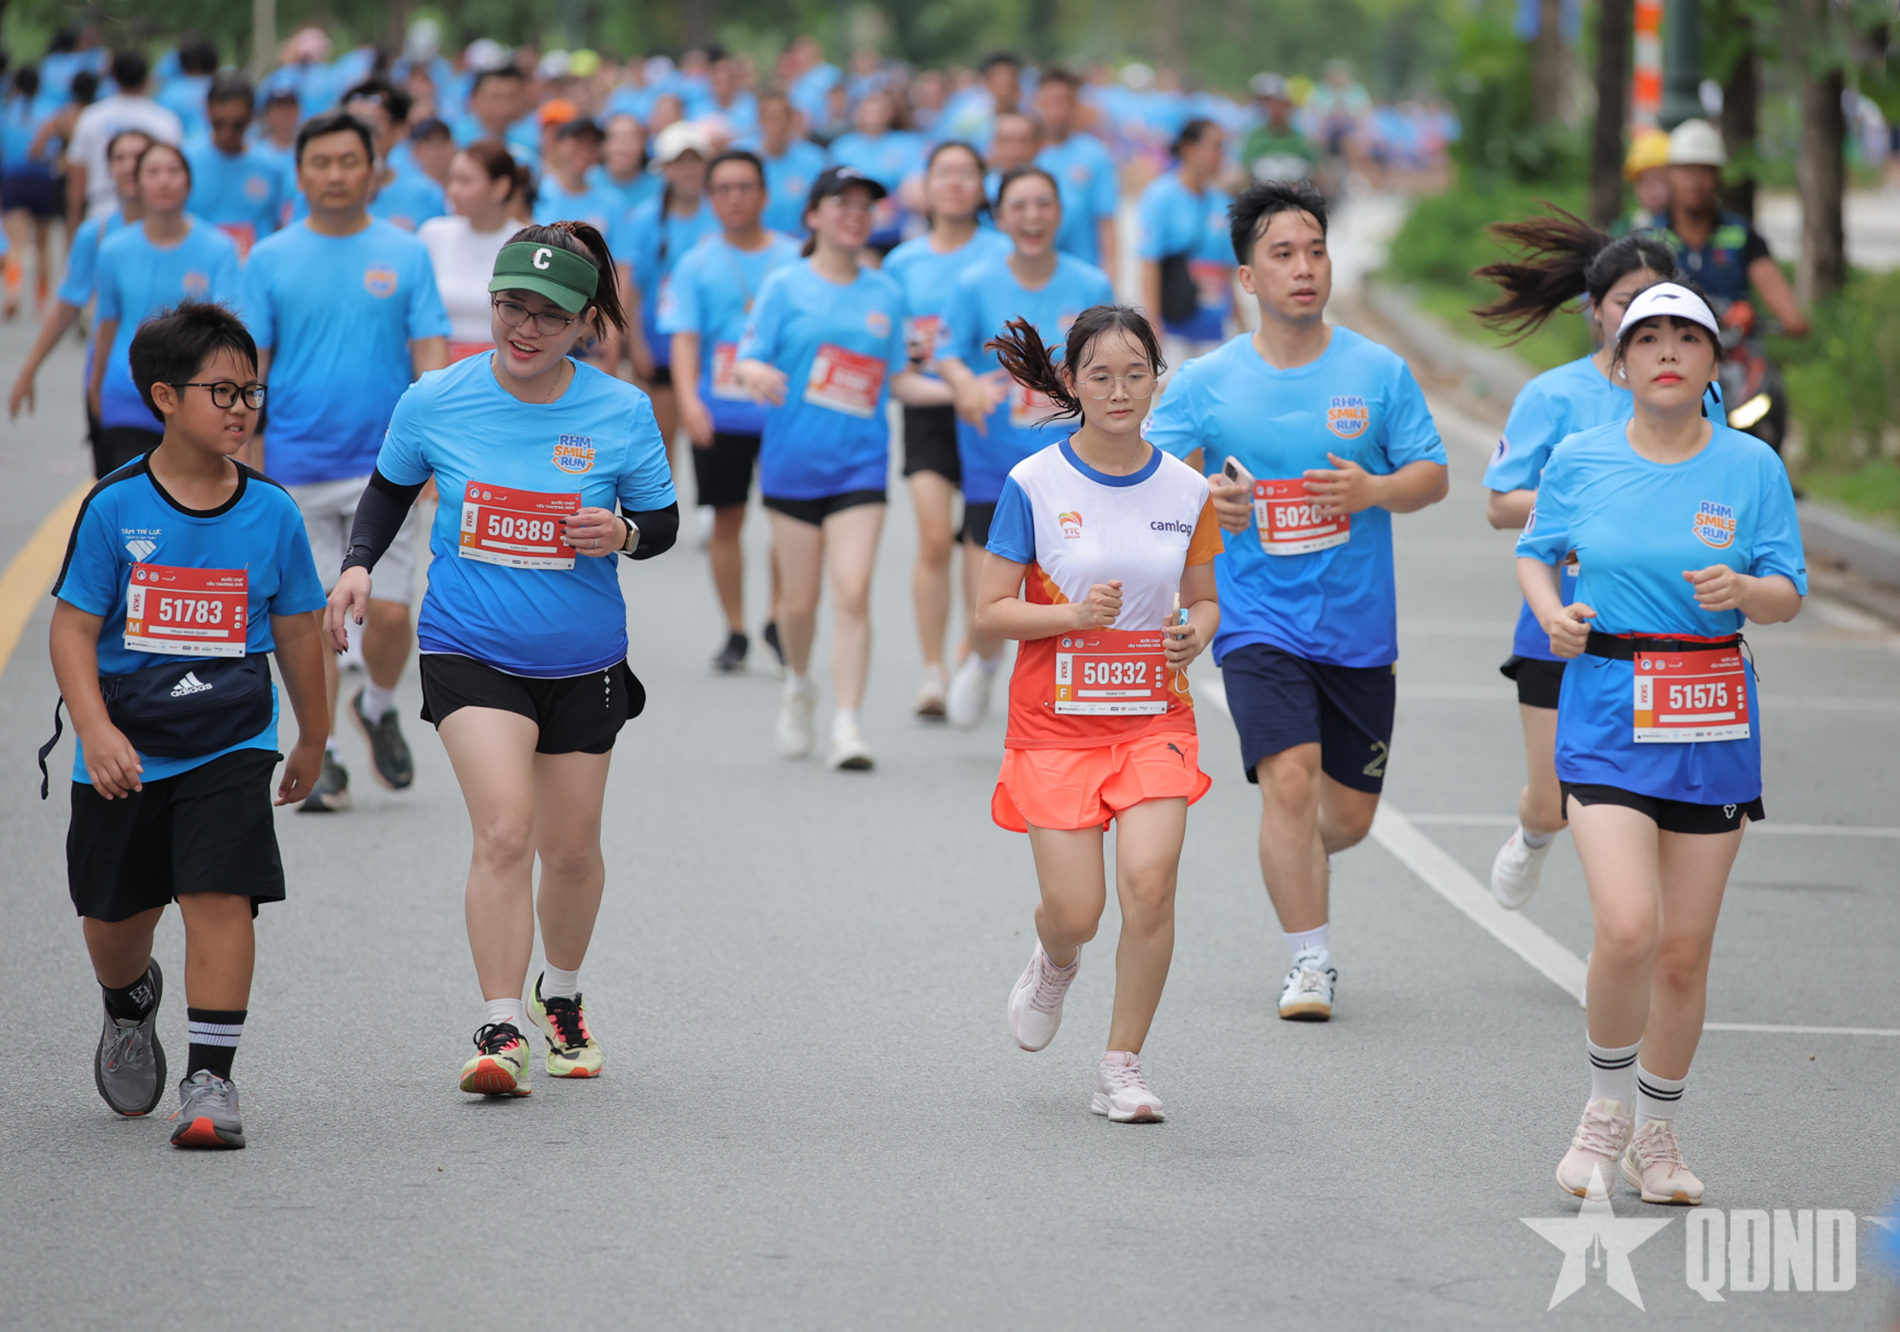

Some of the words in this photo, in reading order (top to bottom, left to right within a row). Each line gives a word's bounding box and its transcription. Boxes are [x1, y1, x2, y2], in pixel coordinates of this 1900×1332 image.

[533, 247, 553, 270] C
[1331, 397, 1364, 408] RHM
[1328, 408, 1369, 420] SMILE
[1336, 420, 1362, 430] RUN
[559, 434, 591, 448] RHM
[553, 445, 595, 460] SMILE
[561, 456, 586, 469] RUN
[1701, 501, 1732, 518] RHM
[466, 510, 474, 528] 5KM
[1694, 513, 1736, 532] SMILE
[487, 514, 555, 542] 50389
[1150, 519, 1192, 537] camlog
[1703, 527, 1728, 541] RUN
[463, 534, 472, 544] F
[132, 594, 141, 613] 5KM
[159, 597, 223, 624] 51783
[128, 621, 140, 634] M
[1083, 661, 1147, 685] 50332
[170, 682, 213, 697] adidas
[1060, 688, 1068, 698] F
[1641, 684, 1649, 703] 5KM
[1669, 682, 1728, 709] 51575
[1362, 740, 1388, 777] 2
